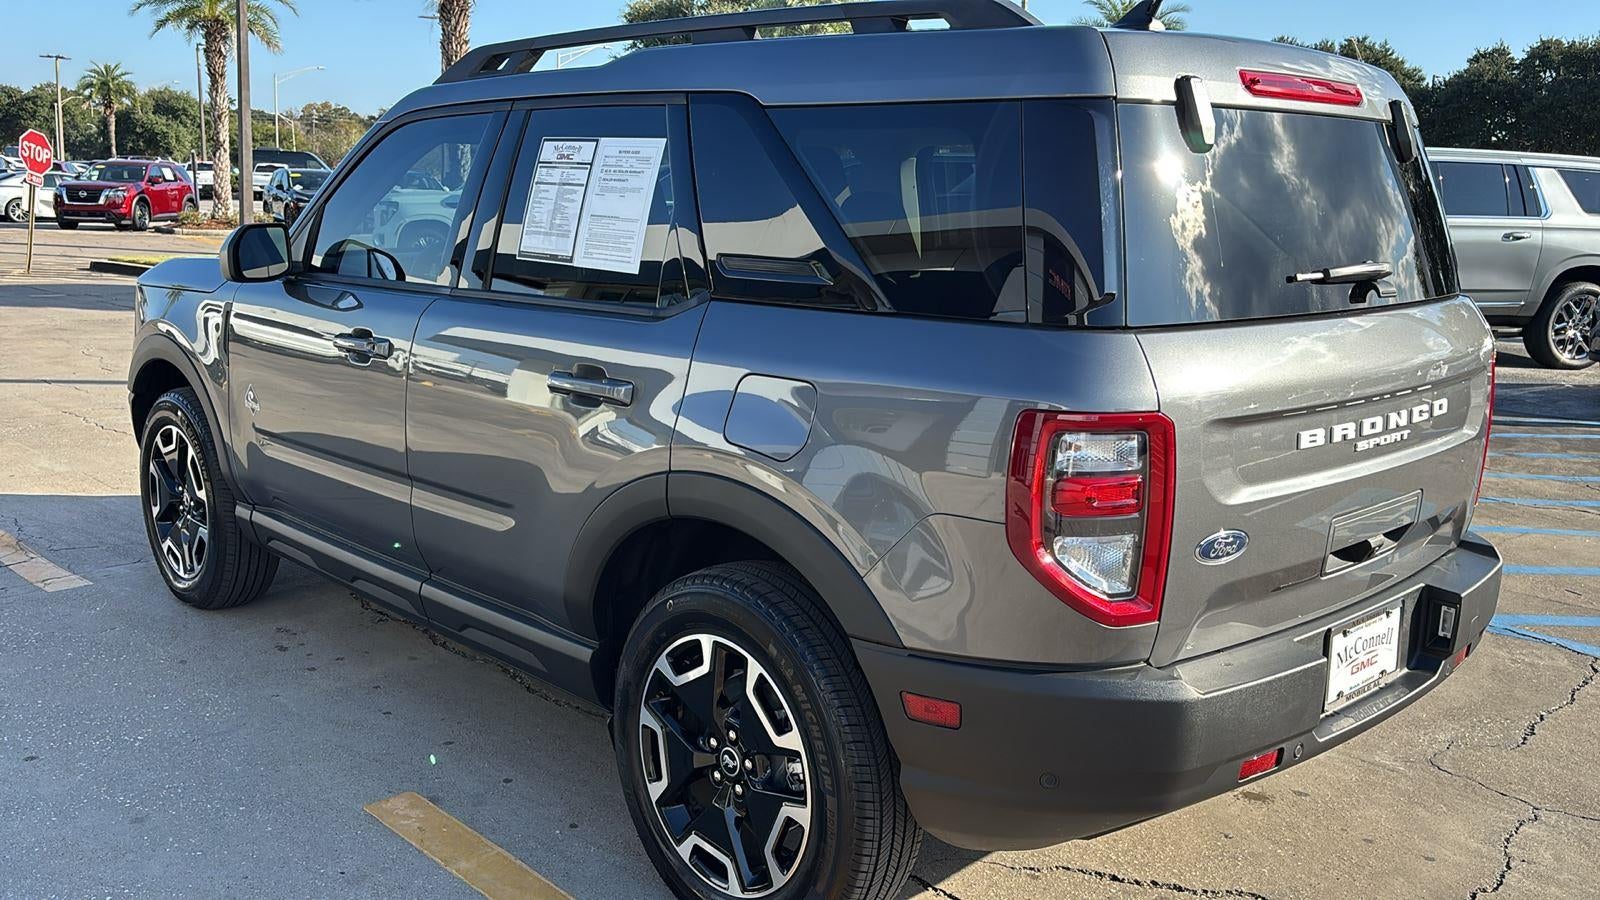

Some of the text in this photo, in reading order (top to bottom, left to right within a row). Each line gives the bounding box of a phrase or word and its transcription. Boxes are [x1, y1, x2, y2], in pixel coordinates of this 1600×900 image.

[21, 141, 51, 164] STOP
[1297, 397, 1449, 450] BRONCO
[1354, 430, 1411, 452] SPORT
[1209, 535, 1240, 558] Ford
[1336, 627, 1394, 669] McConnell
[1350, 653, 1379, 676] GMC
[1345, 684, 1373, 702] MOBILE
[792, 683, 835, 795] MICHELIN
